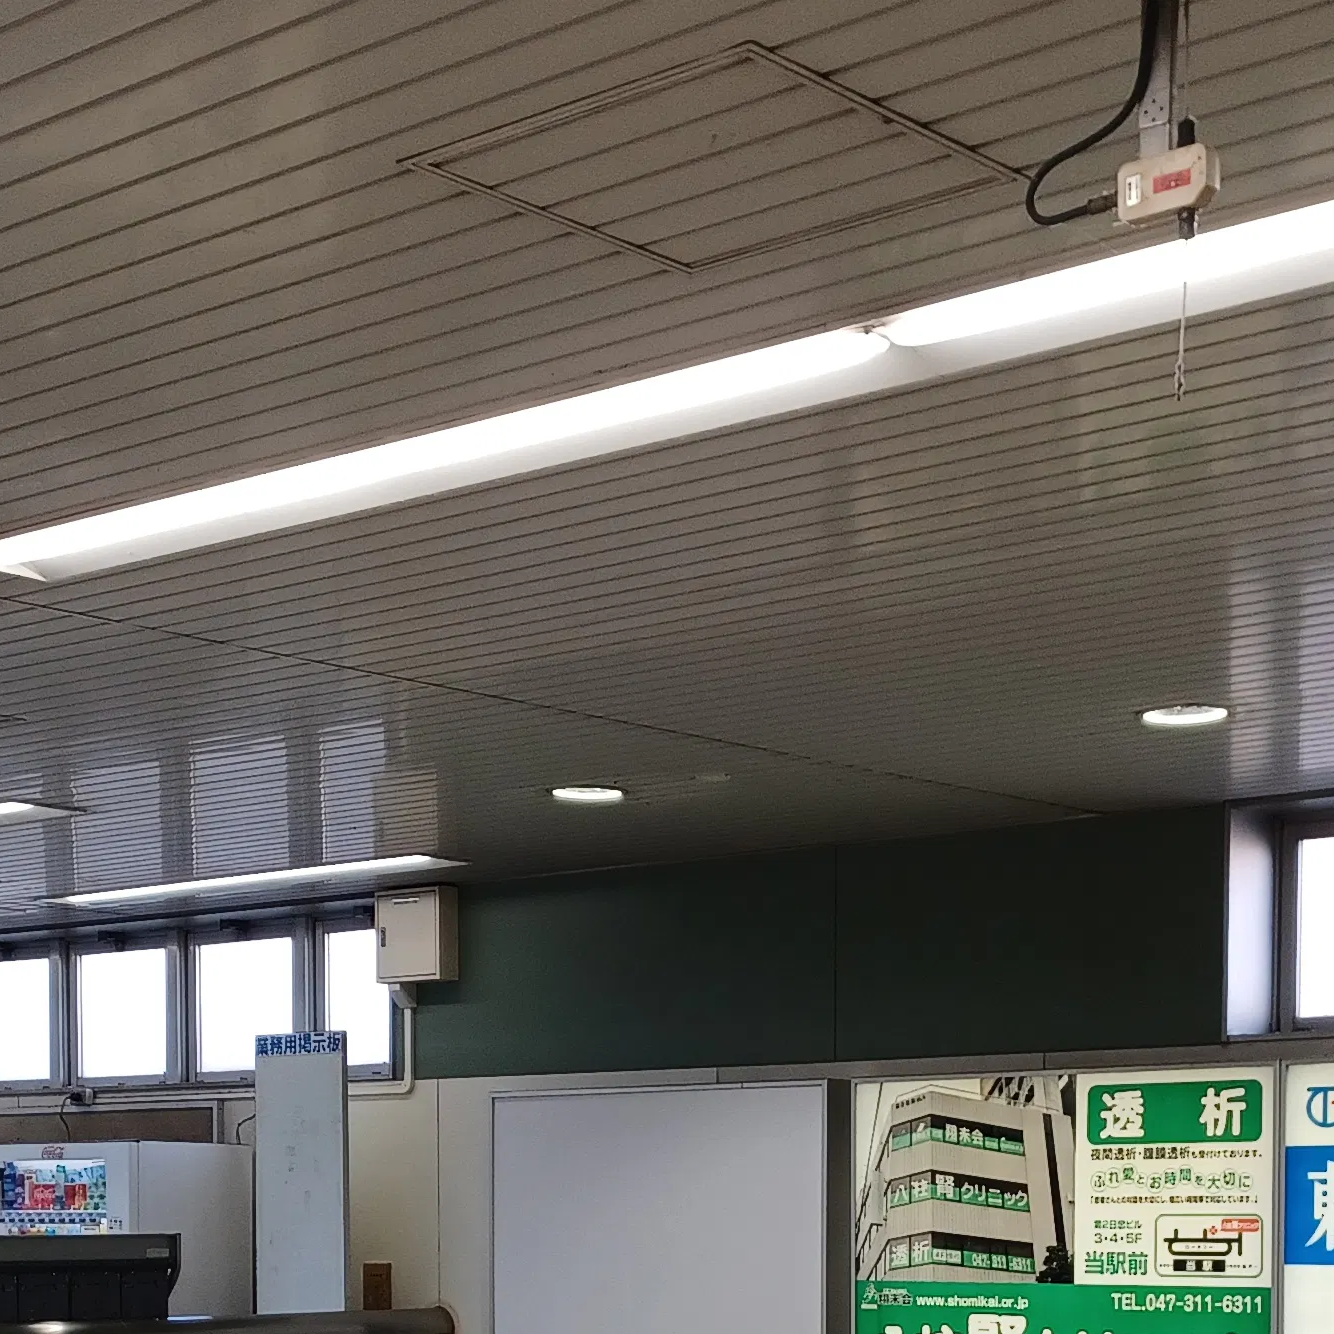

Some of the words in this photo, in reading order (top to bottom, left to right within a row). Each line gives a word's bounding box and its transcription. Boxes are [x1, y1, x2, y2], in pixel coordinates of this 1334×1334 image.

[256, 1033, 341, 1056] 業務用掲示板
[1099, 1087, 1247, 1139] 透析
[893, 1174, 1029, 1207] 八柱腎クリニック
[1092, 1166, 1252, 1190] ふれ愛とお時間を大切に
[891, 1240, 930, 1267] 透析
[1084, 1250, 1148, 1276] 当駅前
[916, 1295, 1029, 1310] www.shomikai.or.jp
[1111, 1292, 1262, 1314] TEL.047-311-6311
